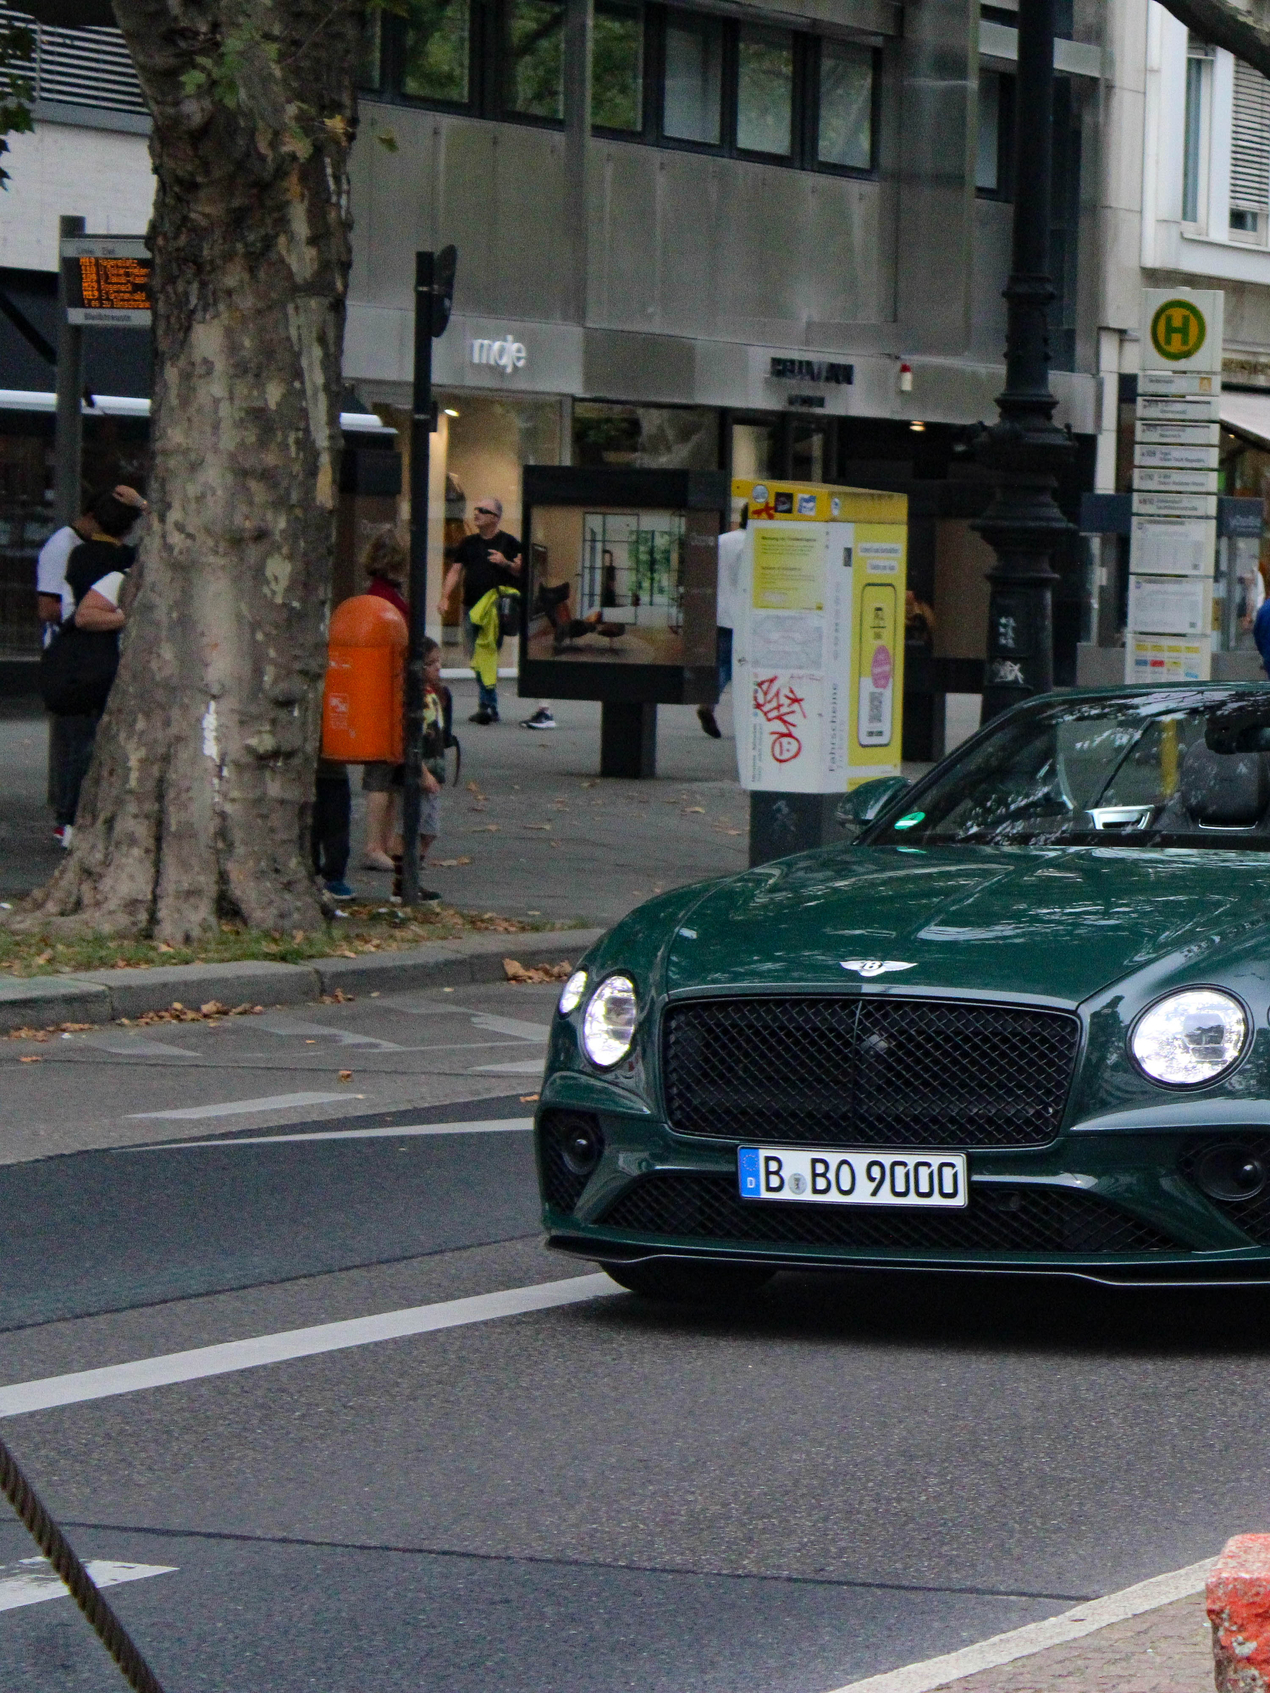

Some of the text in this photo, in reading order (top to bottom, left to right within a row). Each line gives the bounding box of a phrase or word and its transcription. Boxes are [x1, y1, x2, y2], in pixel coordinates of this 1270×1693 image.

[1164, 313, 1191, 347] H
[747, 1177, 756, 1189] D
[764, 1155, 959, 1199] B BO 9000
